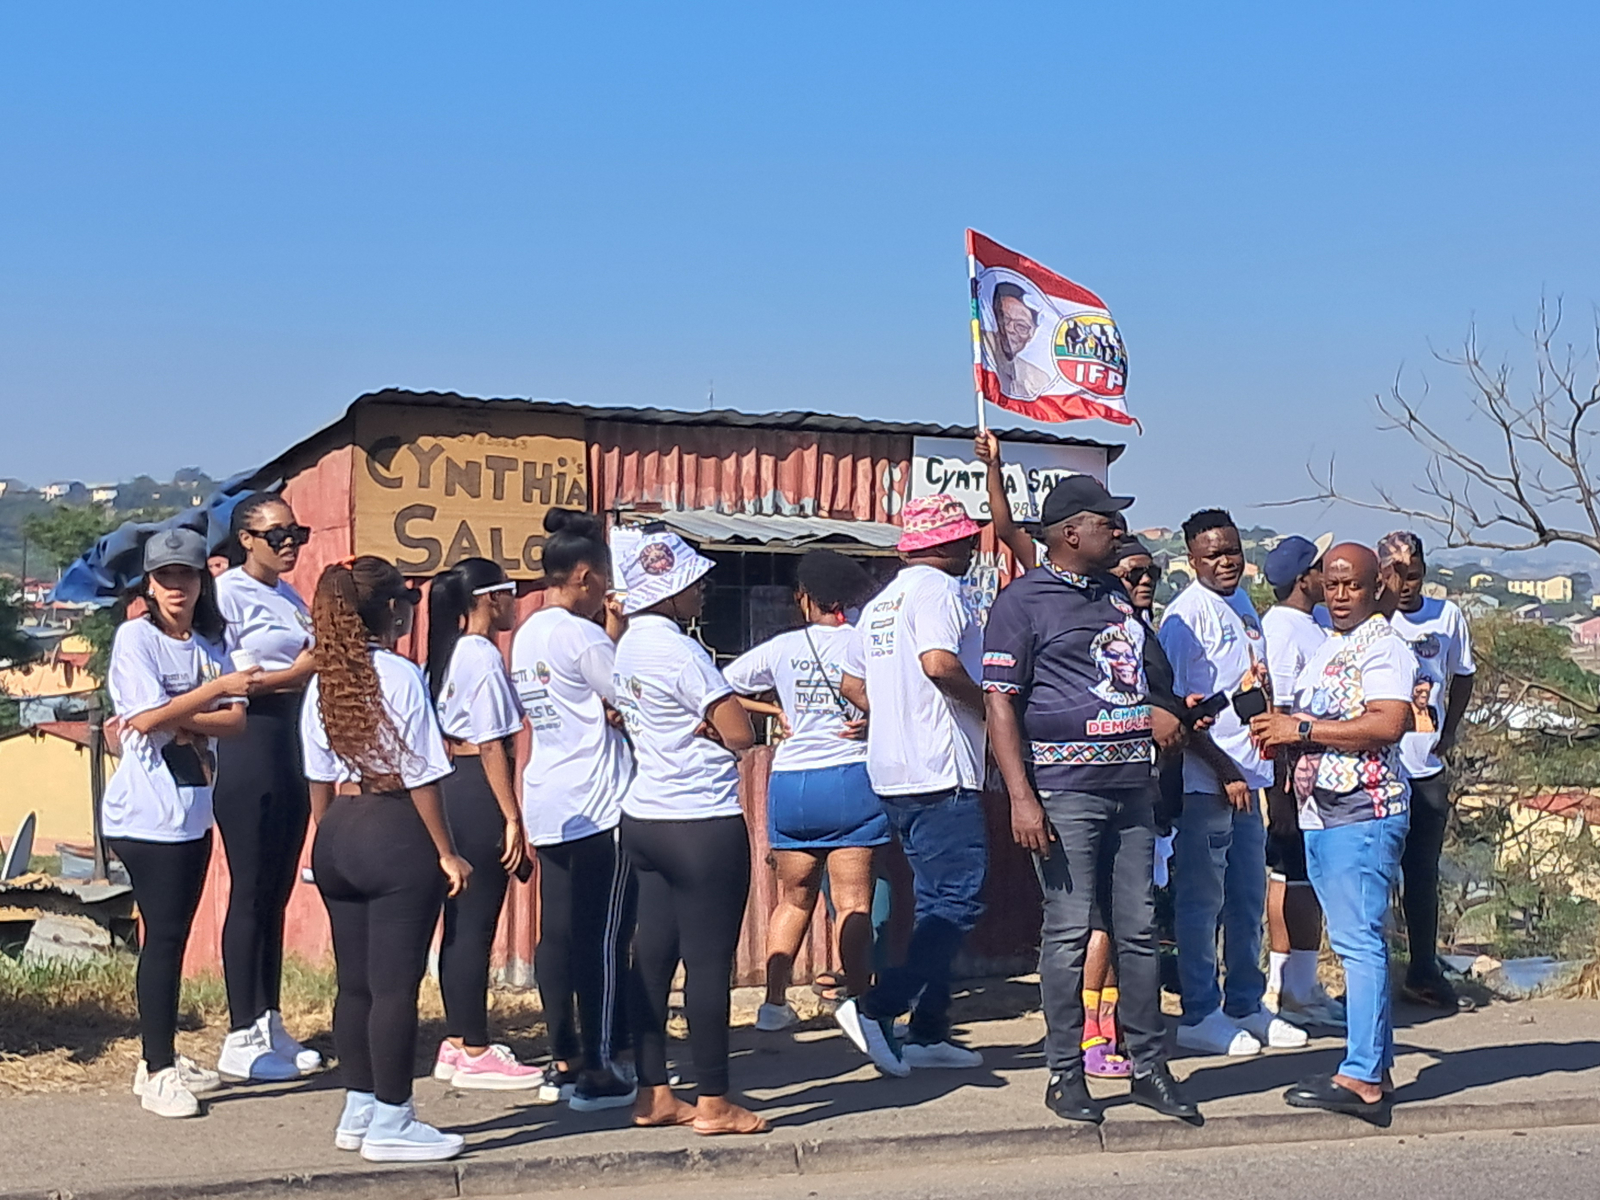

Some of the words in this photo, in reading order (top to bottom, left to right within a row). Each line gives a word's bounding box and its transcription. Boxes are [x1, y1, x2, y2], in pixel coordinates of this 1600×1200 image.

[1076, 363, 1123, 391] IFP
[926, 457, 1017, 494] CyNTA
[1098, 710, 1110, 721] A
